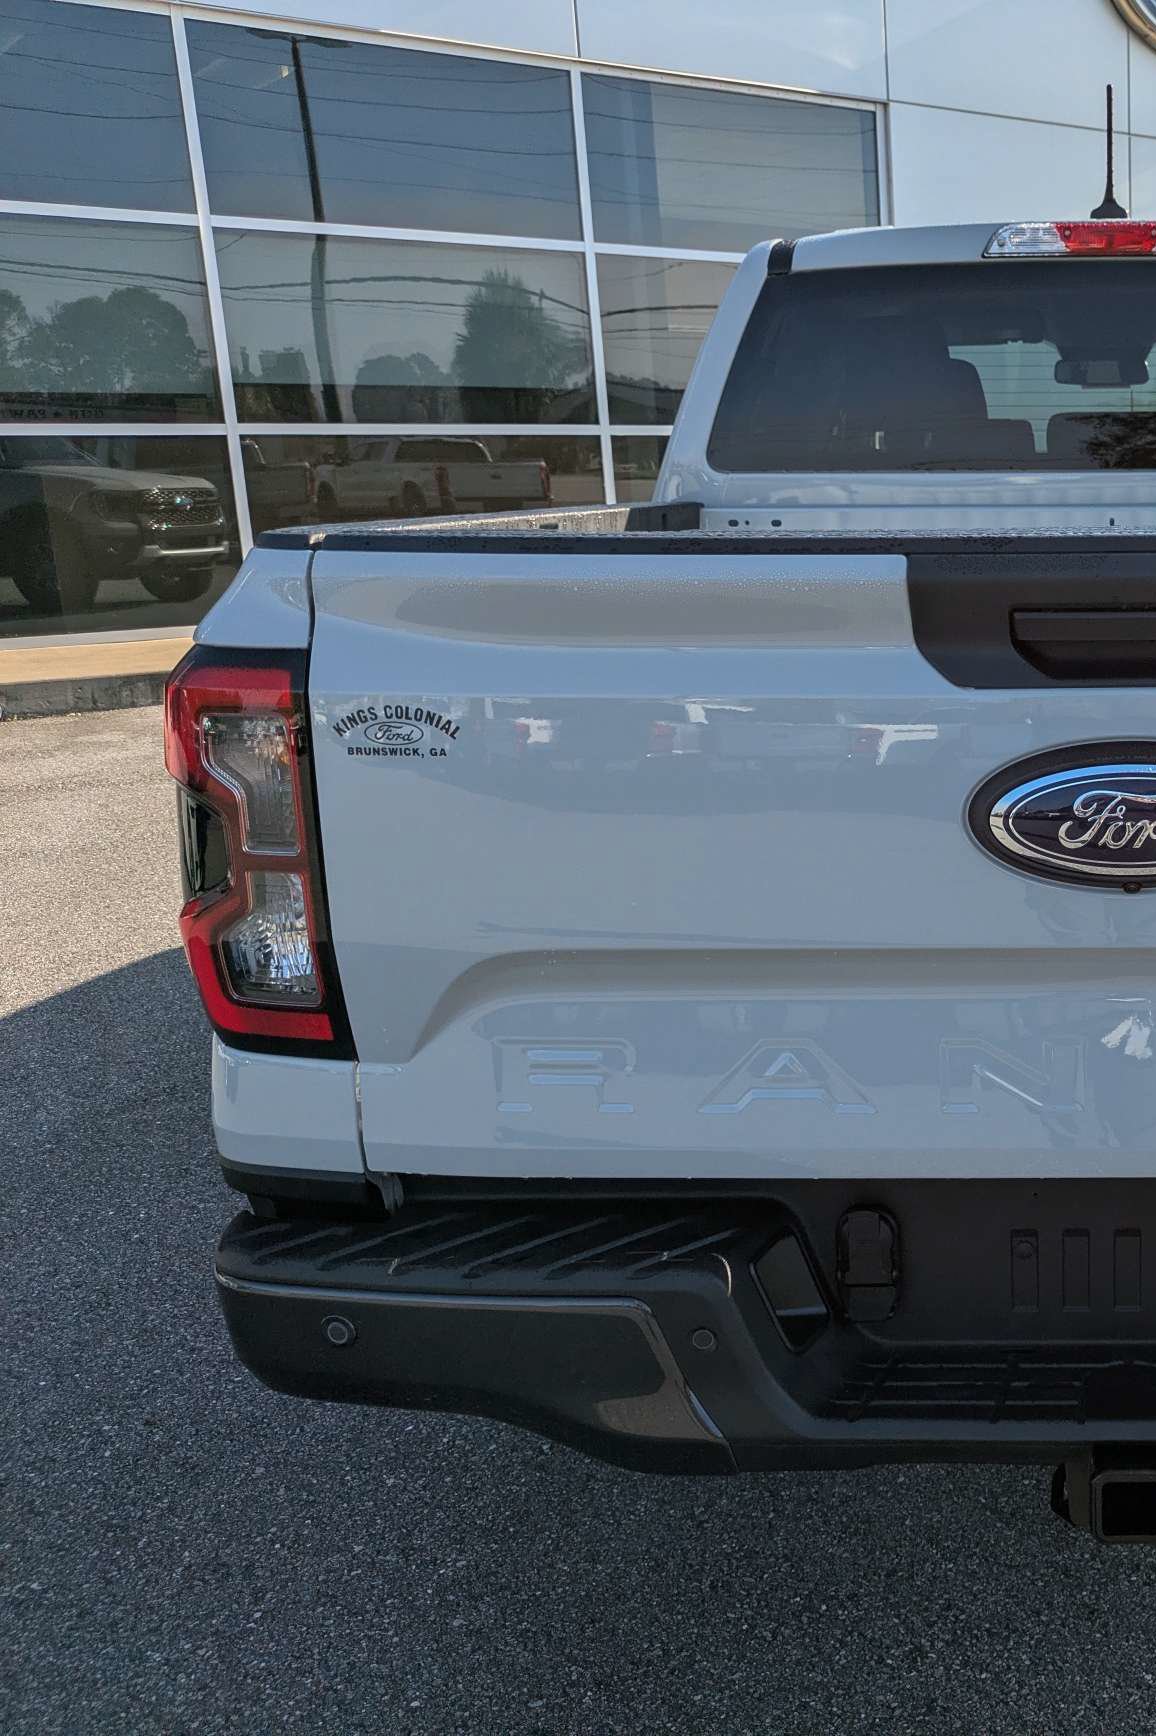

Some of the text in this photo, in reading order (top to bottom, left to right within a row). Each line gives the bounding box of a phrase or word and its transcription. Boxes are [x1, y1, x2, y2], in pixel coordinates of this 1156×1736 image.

[333, 705, 461, 740] KINGS COLONIAL
[374, 724, 414, 742] Ford
[347, 746, 447, 759] BRUNSWICK, GA
